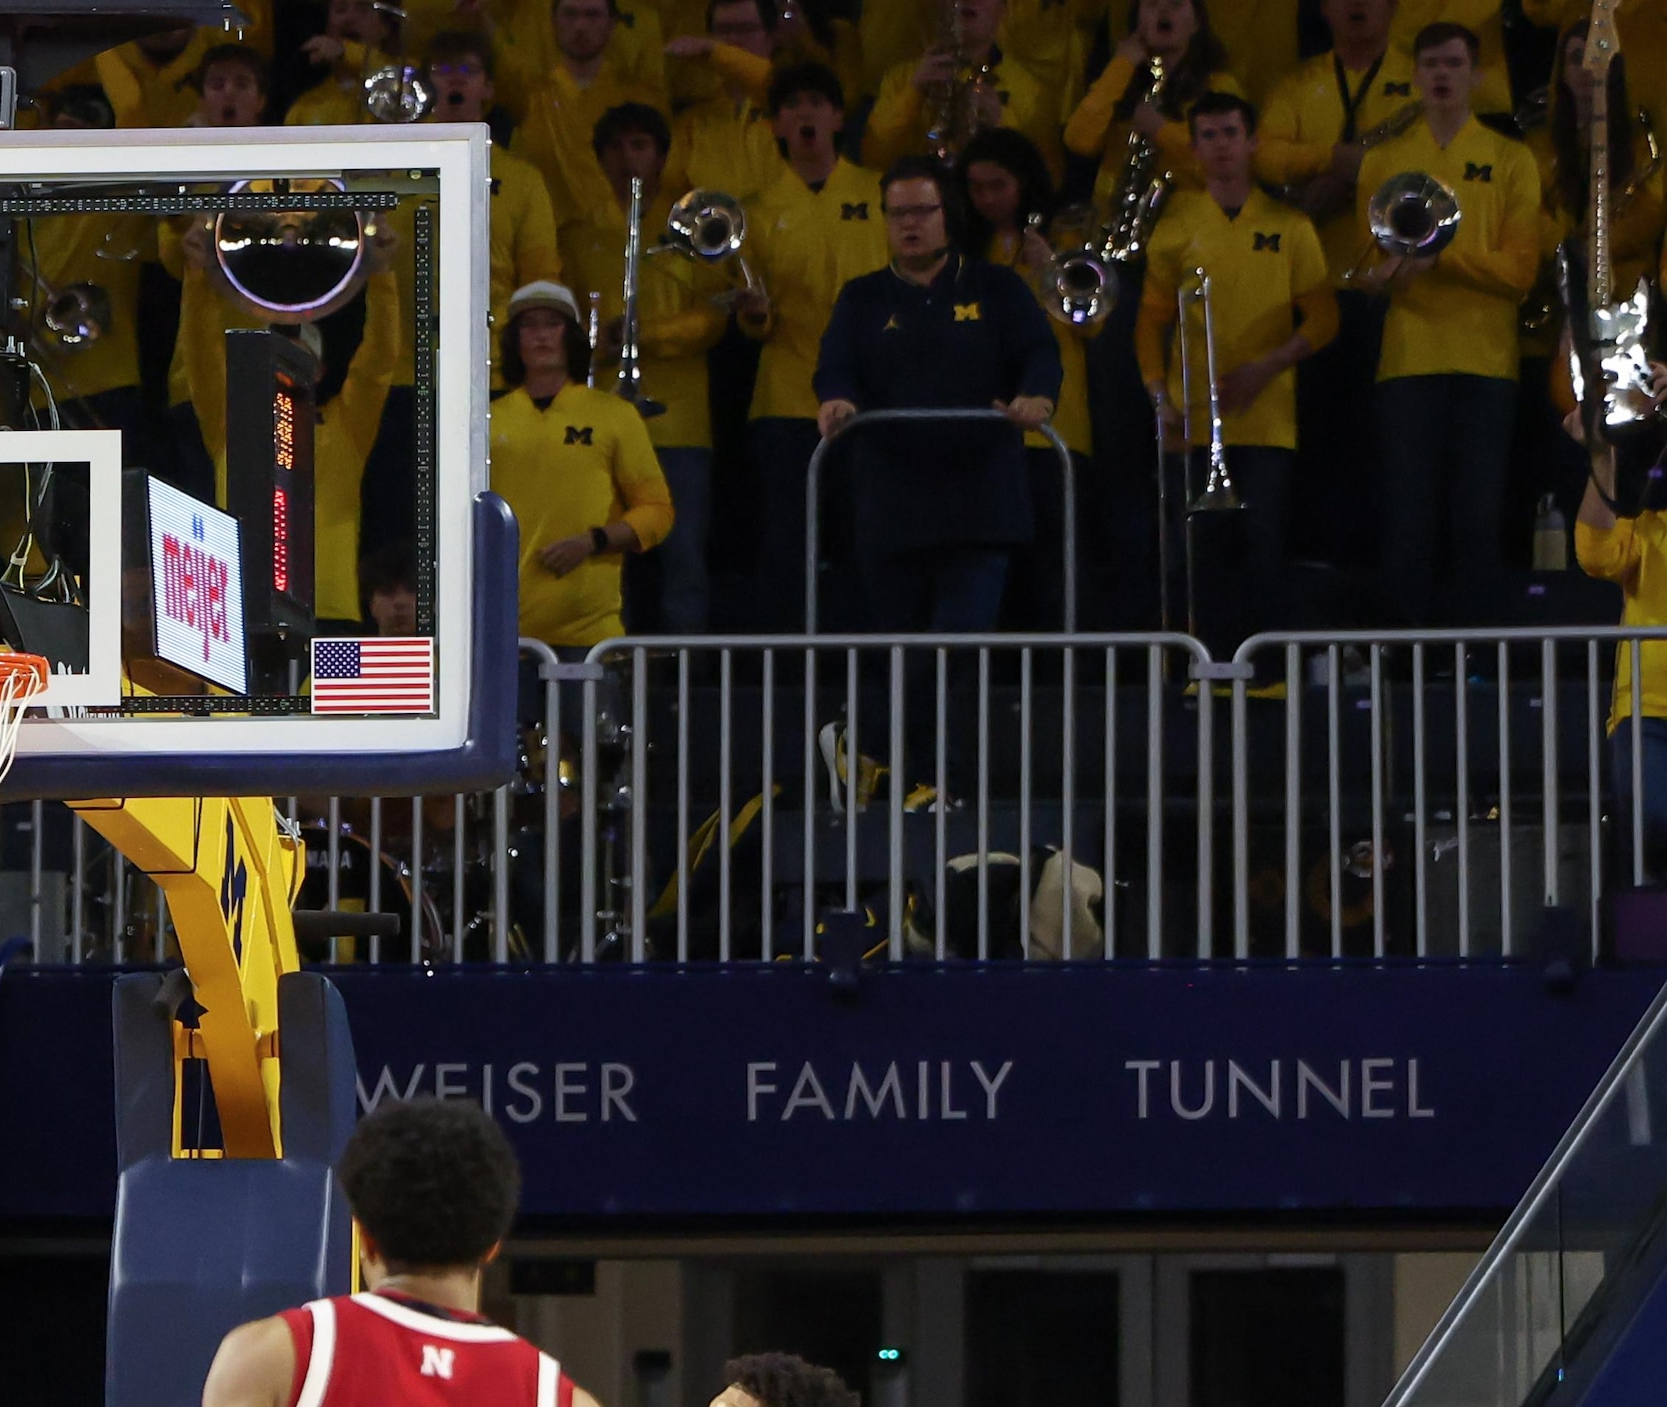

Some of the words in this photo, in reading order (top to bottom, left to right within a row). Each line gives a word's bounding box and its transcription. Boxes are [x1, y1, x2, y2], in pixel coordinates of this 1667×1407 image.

[1463, 162, 1492, 182] M
[841, 202, 870, 220] M
[1252, 232, 1281, 252] M
[953, 303, 981, 322] M
[564, 425, 594, 446] M
[355, 1060, 637, 1123] WEISER
[746, 1059, 1013, 1121] FAMILY
[1124, 1058, 1436, 1119] TUNNEL
[420, 1345, 455, 1380] N
